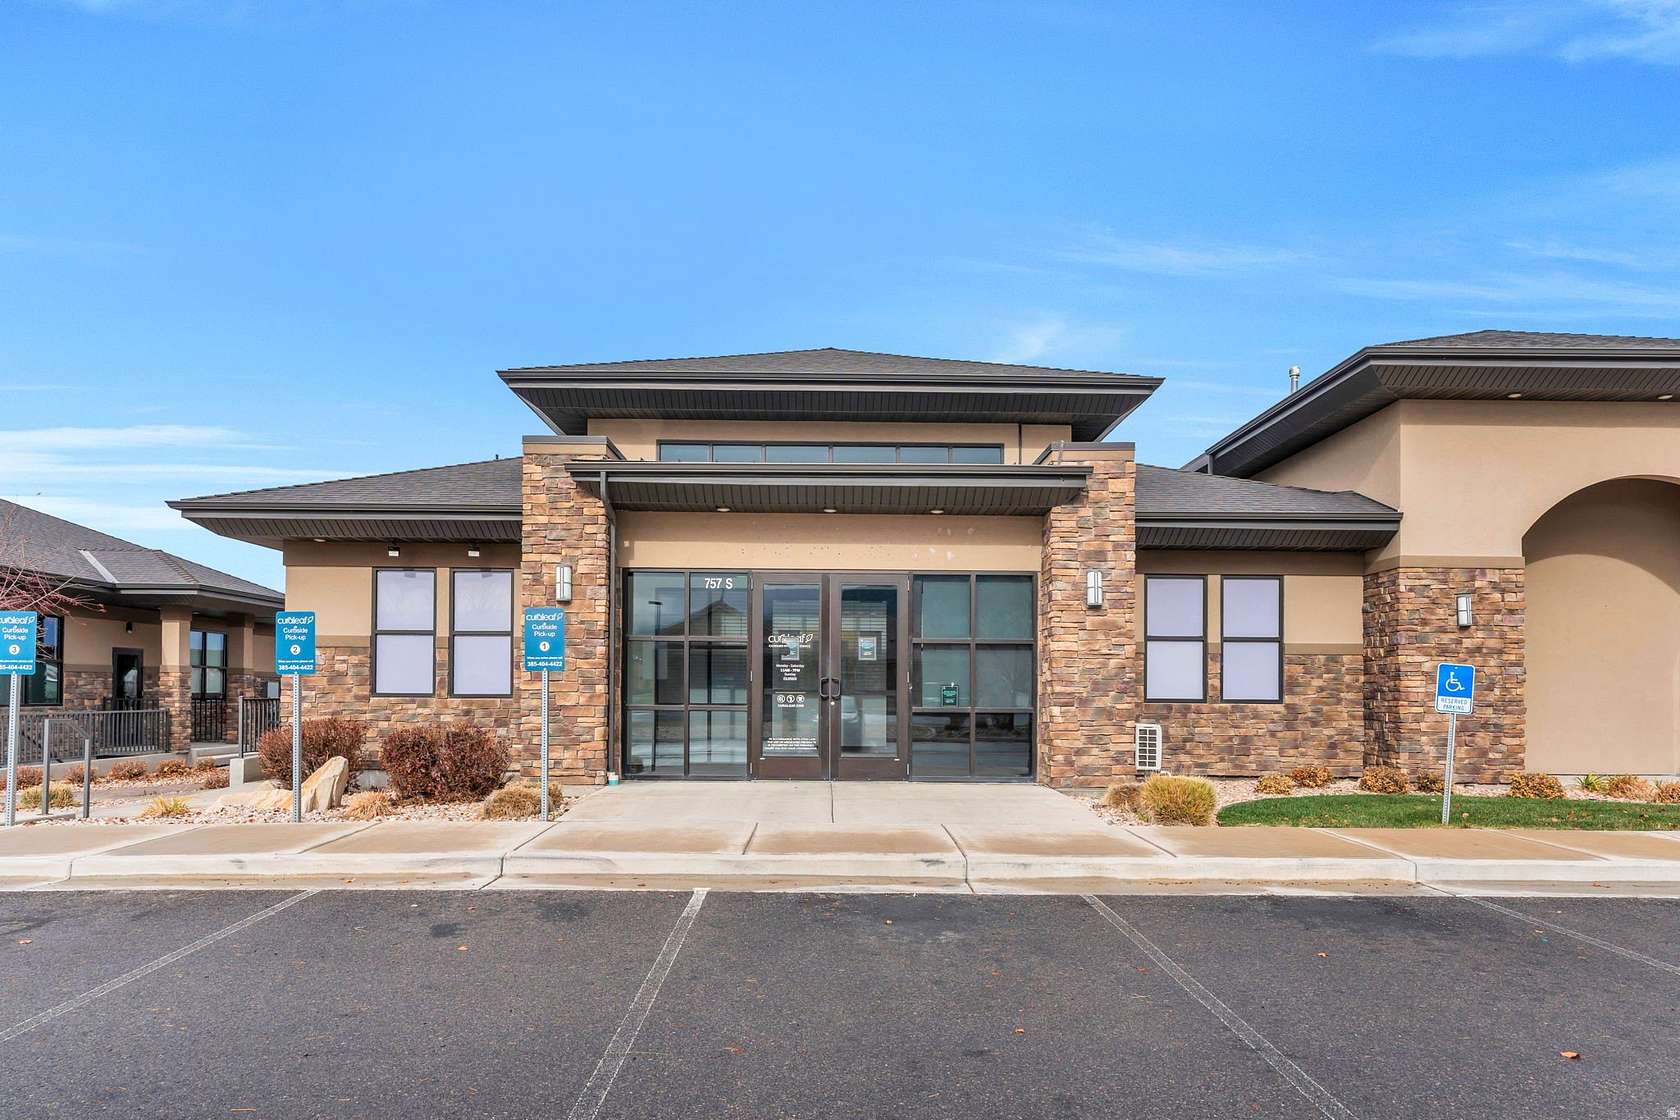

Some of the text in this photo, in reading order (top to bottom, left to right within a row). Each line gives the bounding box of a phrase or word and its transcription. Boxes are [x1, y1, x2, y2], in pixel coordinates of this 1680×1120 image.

[704, 577, 733, 590] 757 S
[1442, 703, 1466, 711] PARKING
